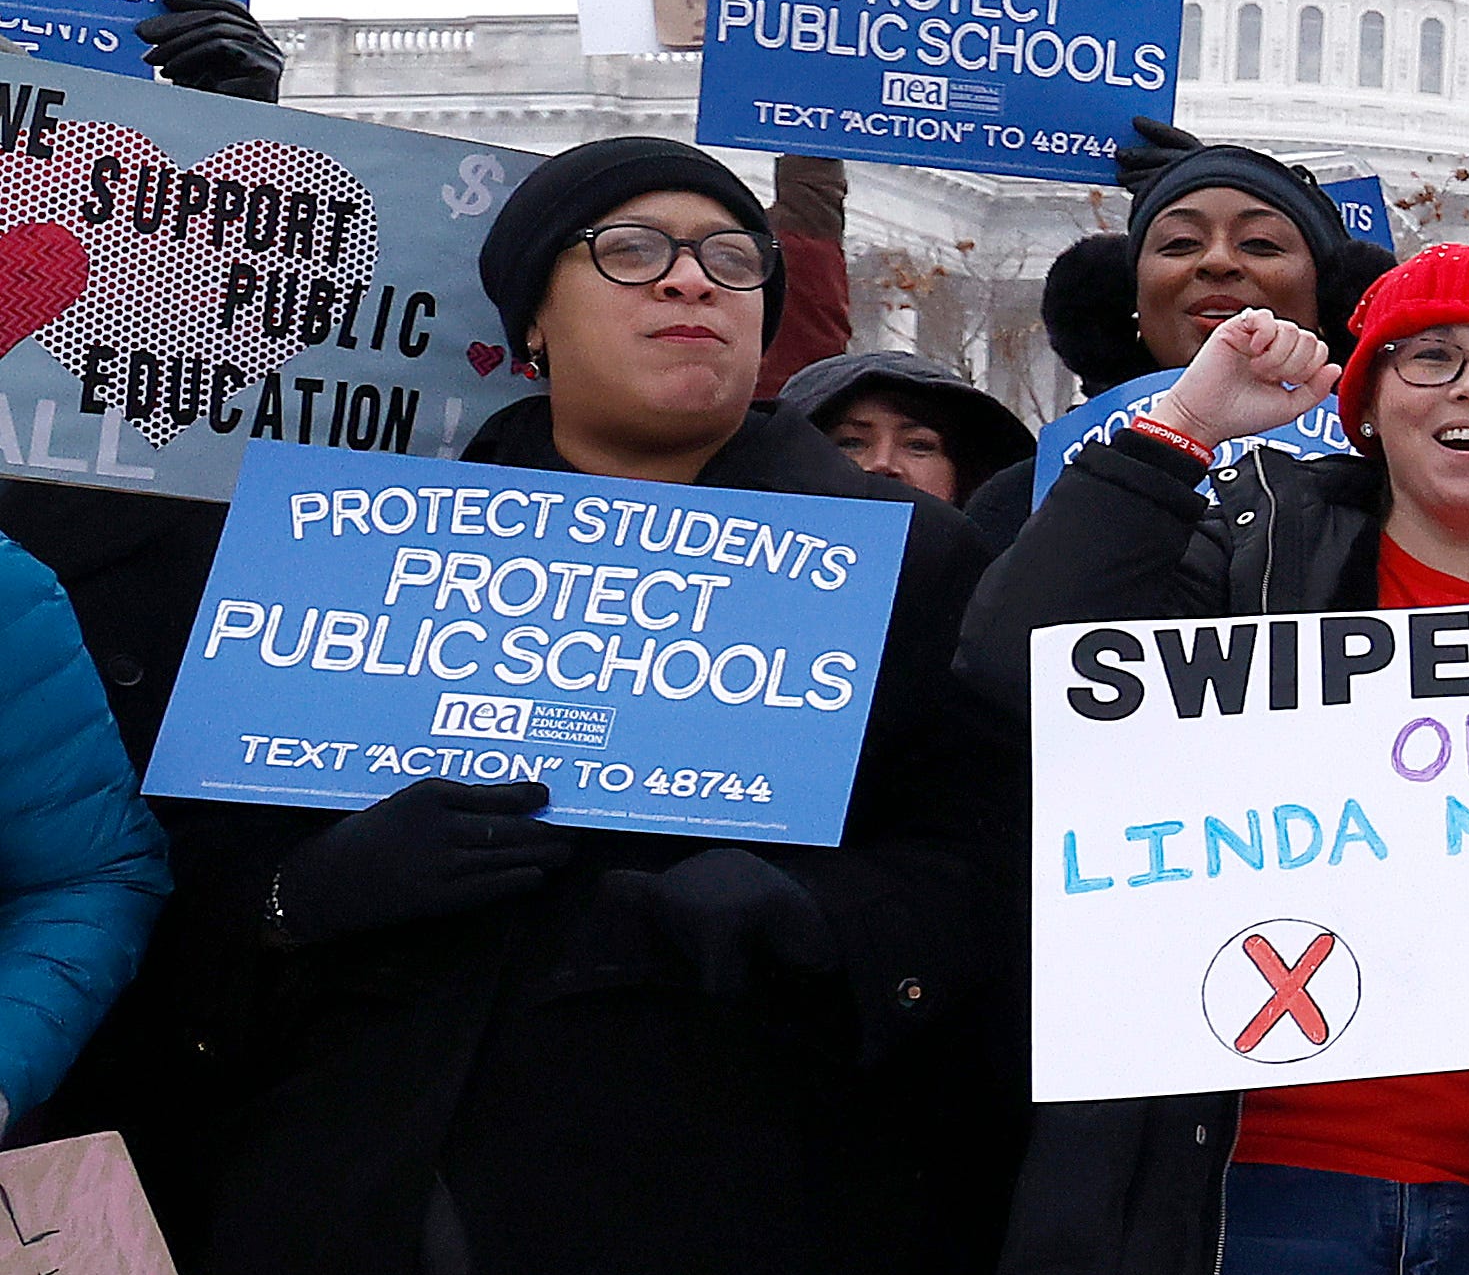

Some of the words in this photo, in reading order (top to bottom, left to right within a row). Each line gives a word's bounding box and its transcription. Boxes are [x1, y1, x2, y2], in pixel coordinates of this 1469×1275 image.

[917, 18, 1166, 89] SCHOOLS
[886, 76, 943, 106] nea
[754, 101, 833, 129] TEXT
[840, 110, 974, 143] "ACTION"
[983, 125, 1025, 149] TO
[1033, 131, 1117, 159] 48744
[83, 155, 361, 268] SUPPORT
[220, 263, 436, 358] PUBLIC
[81, 344, 419, 454] EDUCATION
[290, 487, 563, 539] PROTECT
[568, 497, 856, 591] STUDENTS
[383, 546, 730, 633] PROTECT
[203, 600, 486, 679] PUBLIC
[494, 626, 857, 711] SCHOOLS
[439, 701, 522, 734] nea
[528, 730, 603, 744] ASSOCIATION
[531, 718, 606, 733] EDUCATION
[534, 706, 608, 722] NATIONAL
[241, 735, 356, 770] TEXT
[364, 747, 559, 783] "ACTION"
[574, 760, 634, 793] TO
[644, 769, 772, 803] 48744
[1063, 798, 1388, 895] LINDA
